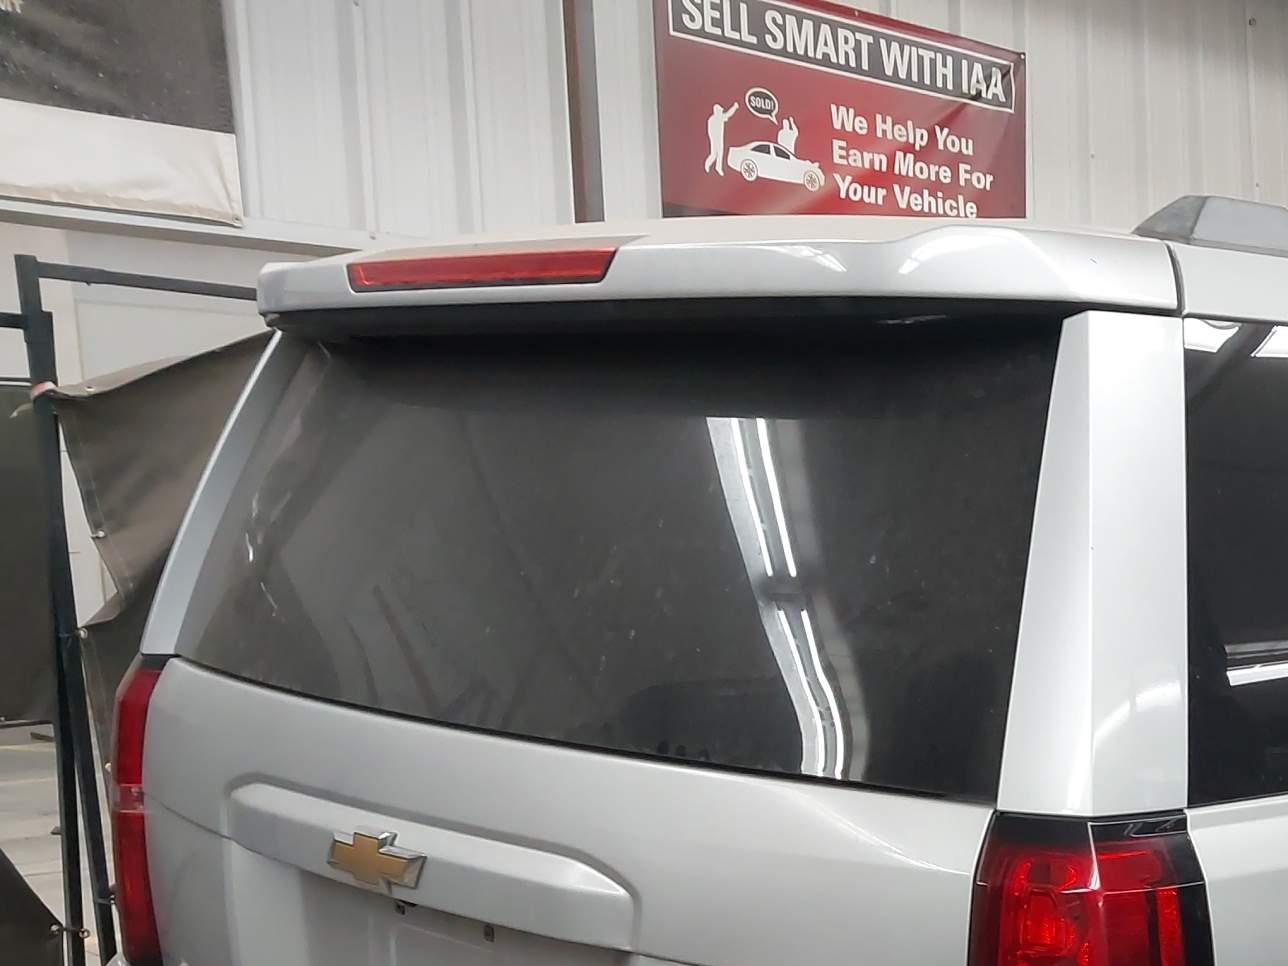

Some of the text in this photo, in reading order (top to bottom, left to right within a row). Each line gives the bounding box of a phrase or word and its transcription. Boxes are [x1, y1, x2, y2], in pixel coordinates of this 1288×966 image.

[681, 0, 1007, 102] SELL SMART WITH IAA
[750, 95, 775, 110] SOLD!
[830, 103, 974, 156] We Help You
[832, 139, 994, 191] Earn More For
[832, 173, 978, 218] Your Vehicle
